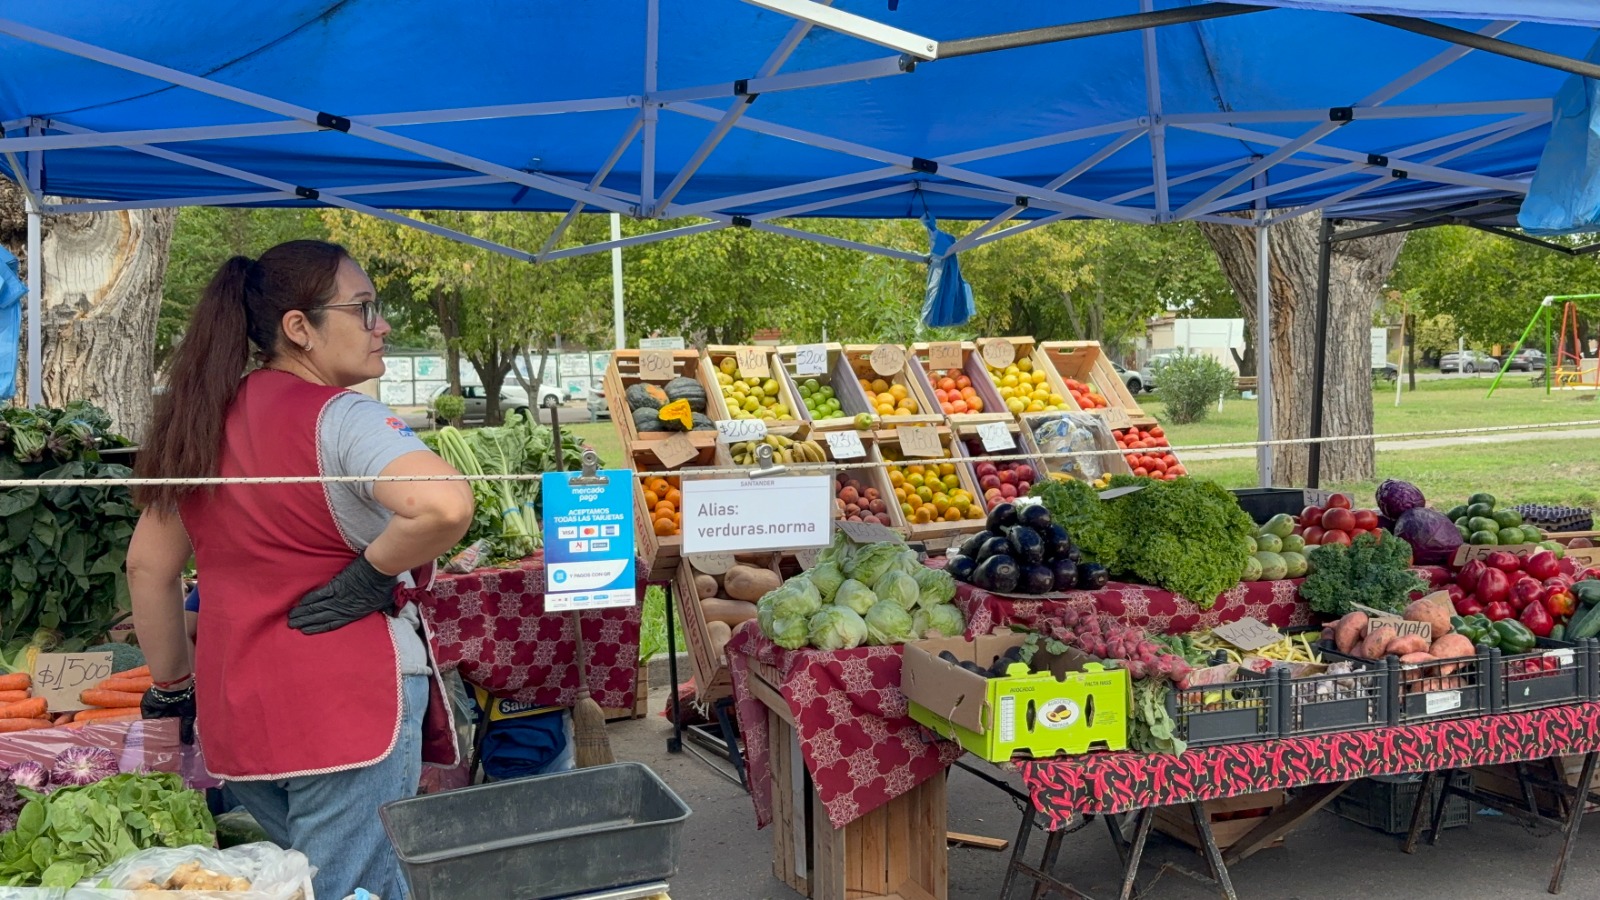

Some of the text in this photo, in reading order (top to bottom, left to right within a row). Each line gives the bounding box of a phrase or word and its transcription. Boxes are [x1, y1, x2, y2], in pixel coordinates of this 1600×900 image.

[641, 354, 671, 372] $800
[738, 351, 767, 370] $1800
[571, 487, 605, 495] mercado
[579, 494, 598, 502] pago
[568, 508, 610, 516] ACEPTAMOS
[697, 502, 739, 517] Alias:
[697, 522, 816, 538] verduras.norma
[37, 655, 111, 691] $1500
